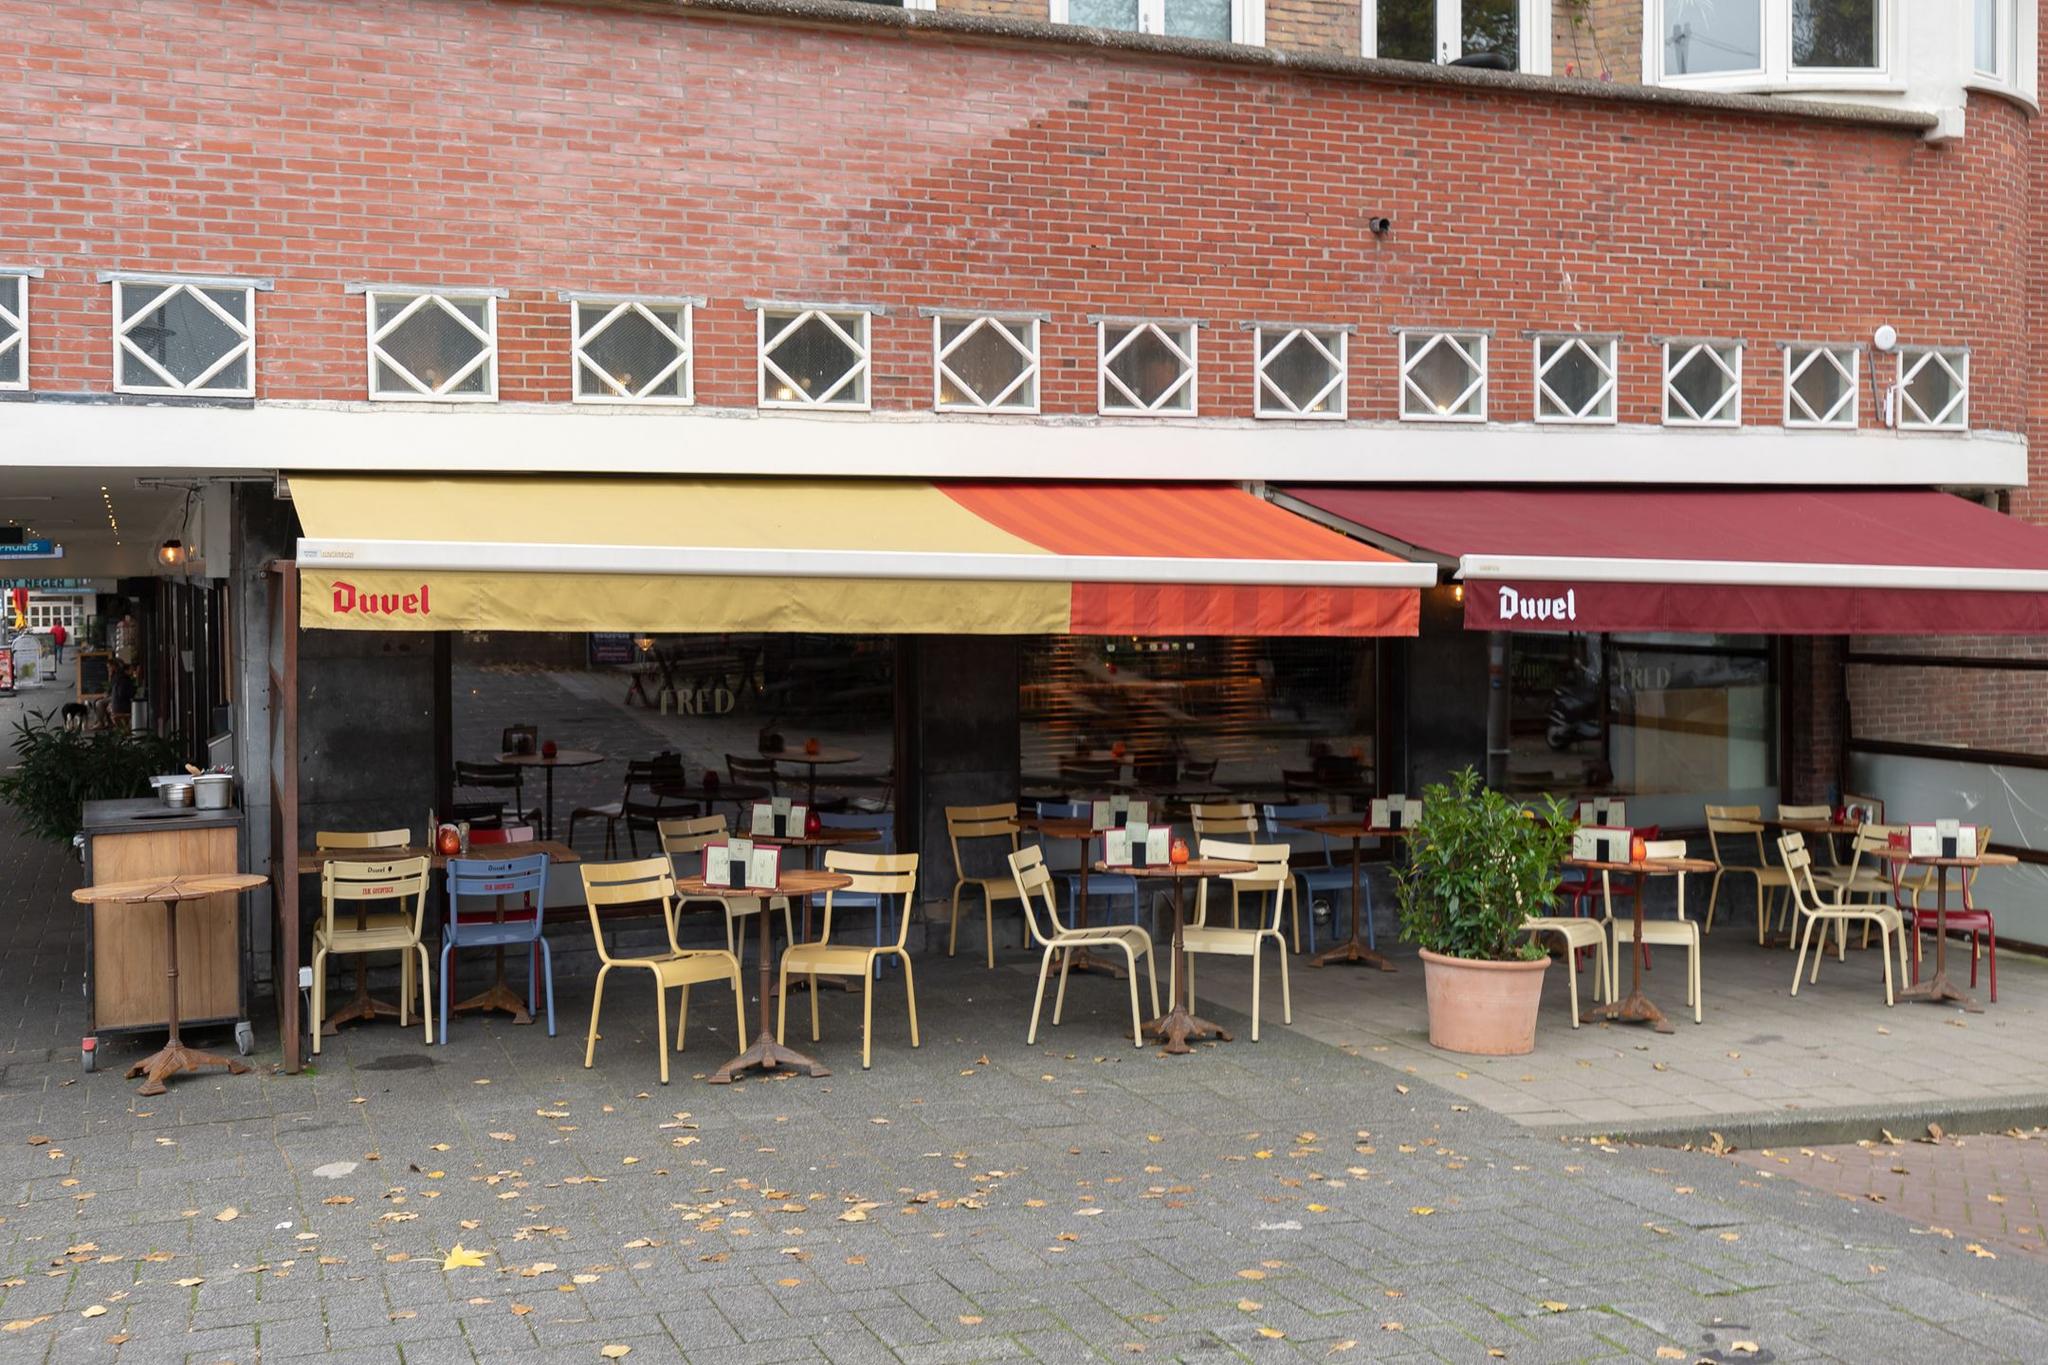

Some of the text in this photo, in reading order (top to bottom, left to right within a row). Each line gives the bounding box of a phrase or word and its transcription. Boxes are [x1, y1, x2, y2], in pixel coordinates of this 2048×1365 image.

[331, 581, 430, 615] Duvel
[1499, 585, 1576, 621] Duvel
[660, 688, 736, 716] FRED
